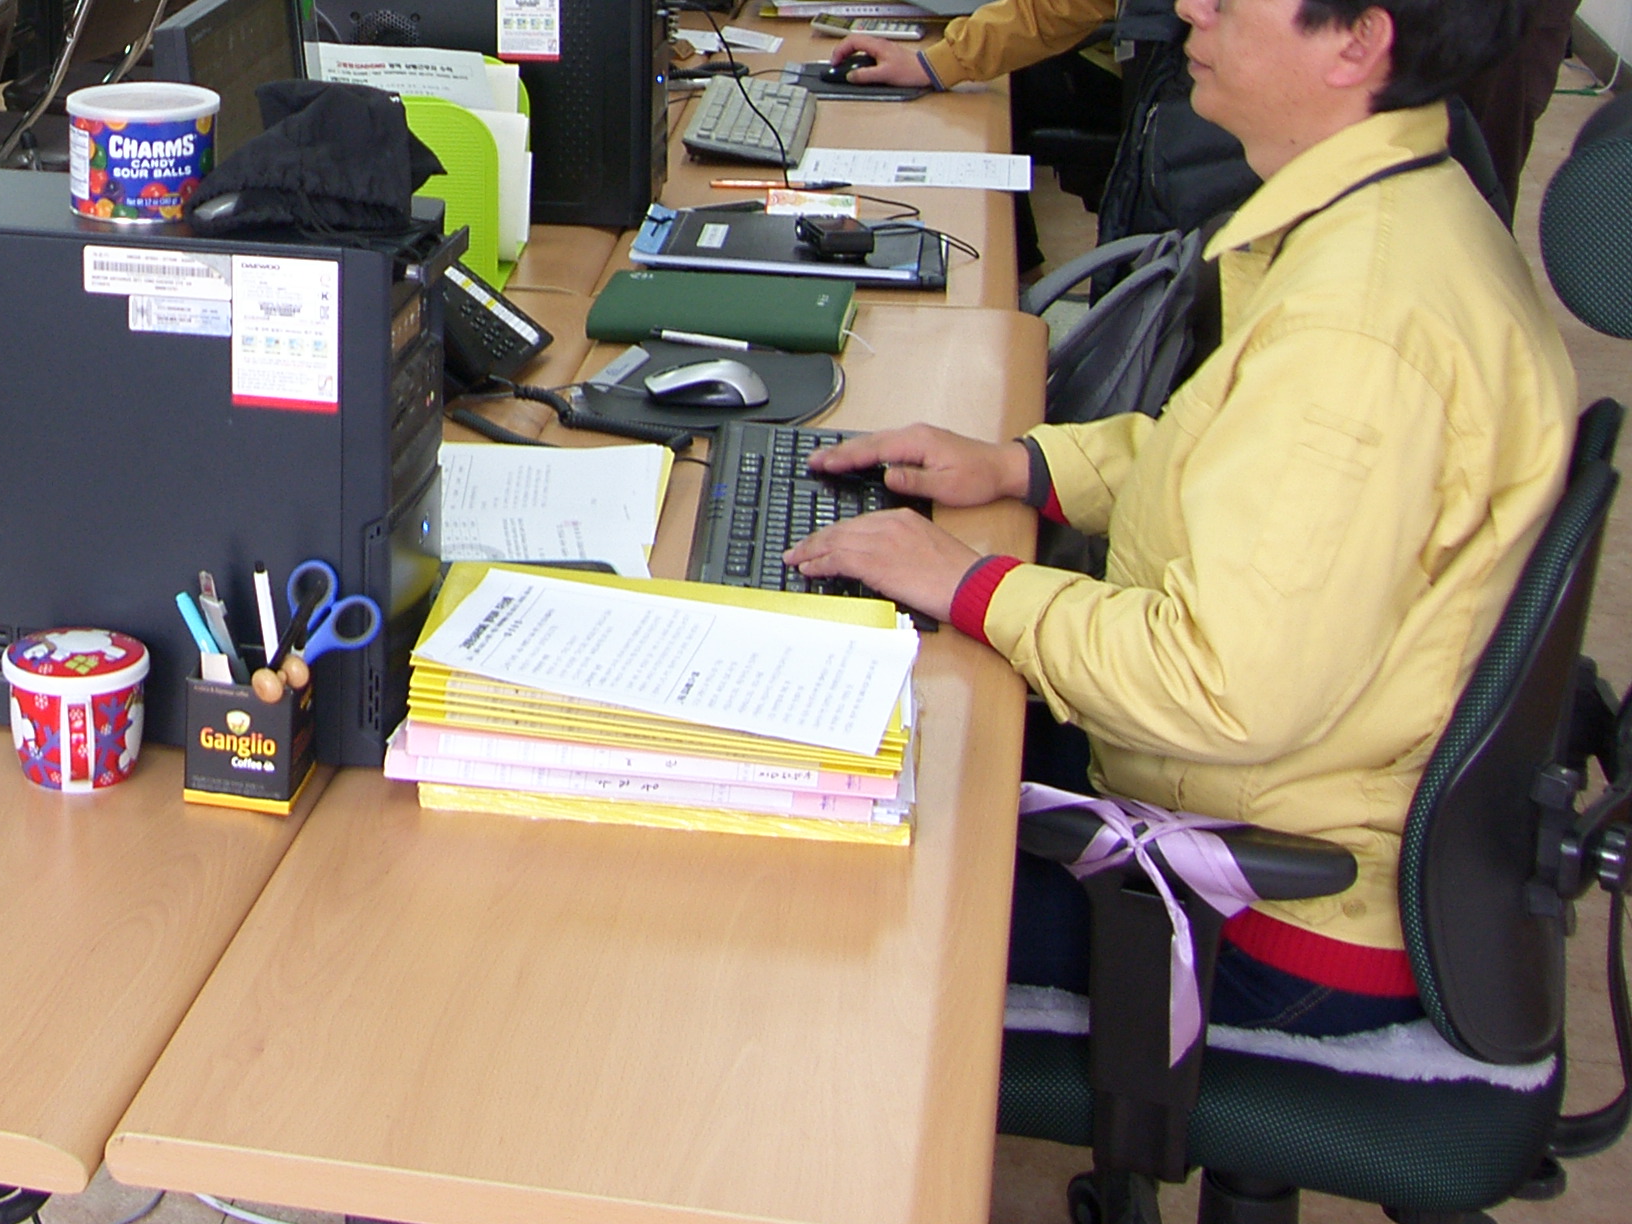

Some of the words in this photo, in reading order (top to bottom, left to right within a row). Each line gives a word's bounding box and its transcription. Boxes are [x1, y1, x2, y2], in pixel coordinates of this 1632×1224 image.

[108, 133, 195, 160] CHARMS
[131, 159, 176, 169] CANDY
[113, 167, 149, 179] SOUR
[153, 165, 192, 178] BALLS
[241, 262, 281, 271] DAEWOO
[200, 726, 277, 758] Ganglio
[231, 755, 262, 771] Coffee
